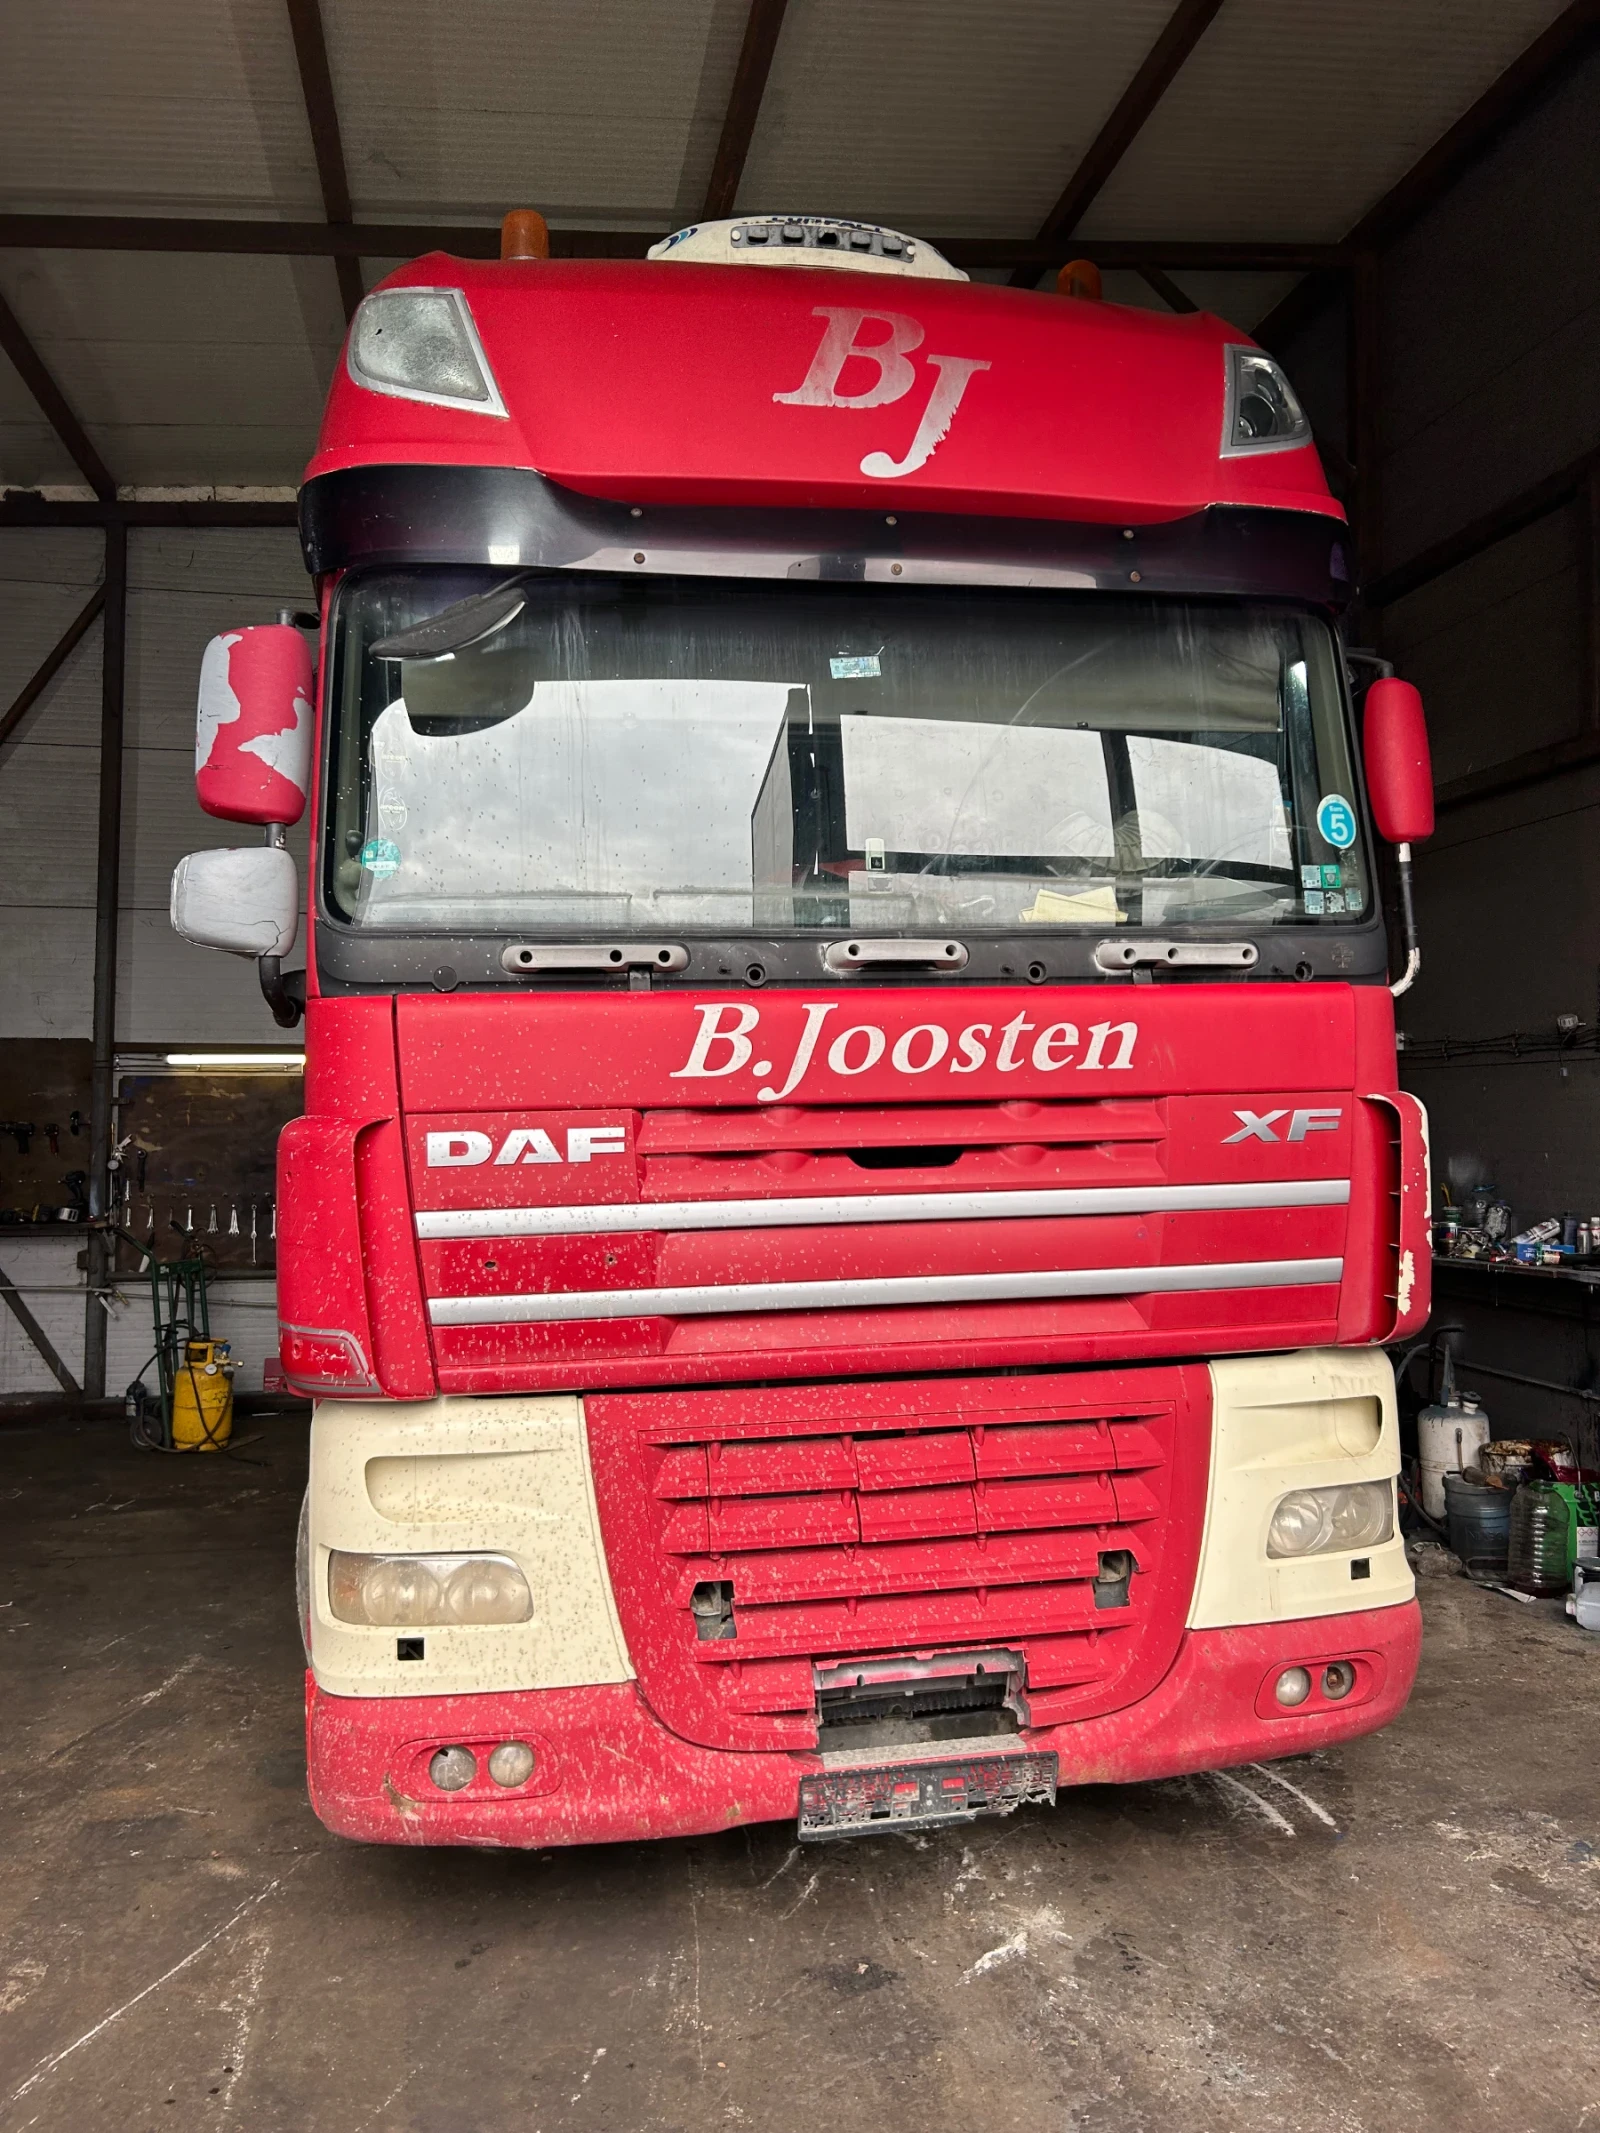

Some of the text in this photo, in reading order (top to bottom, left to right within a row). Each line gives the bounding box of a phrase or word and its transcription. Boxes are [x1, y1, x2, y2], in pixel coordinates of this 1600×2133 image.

[1331, 813, 1348, 841] 5
[1221, 1109, 1343, 1144] XF
[426, 1127, 626, 1167] DAF
